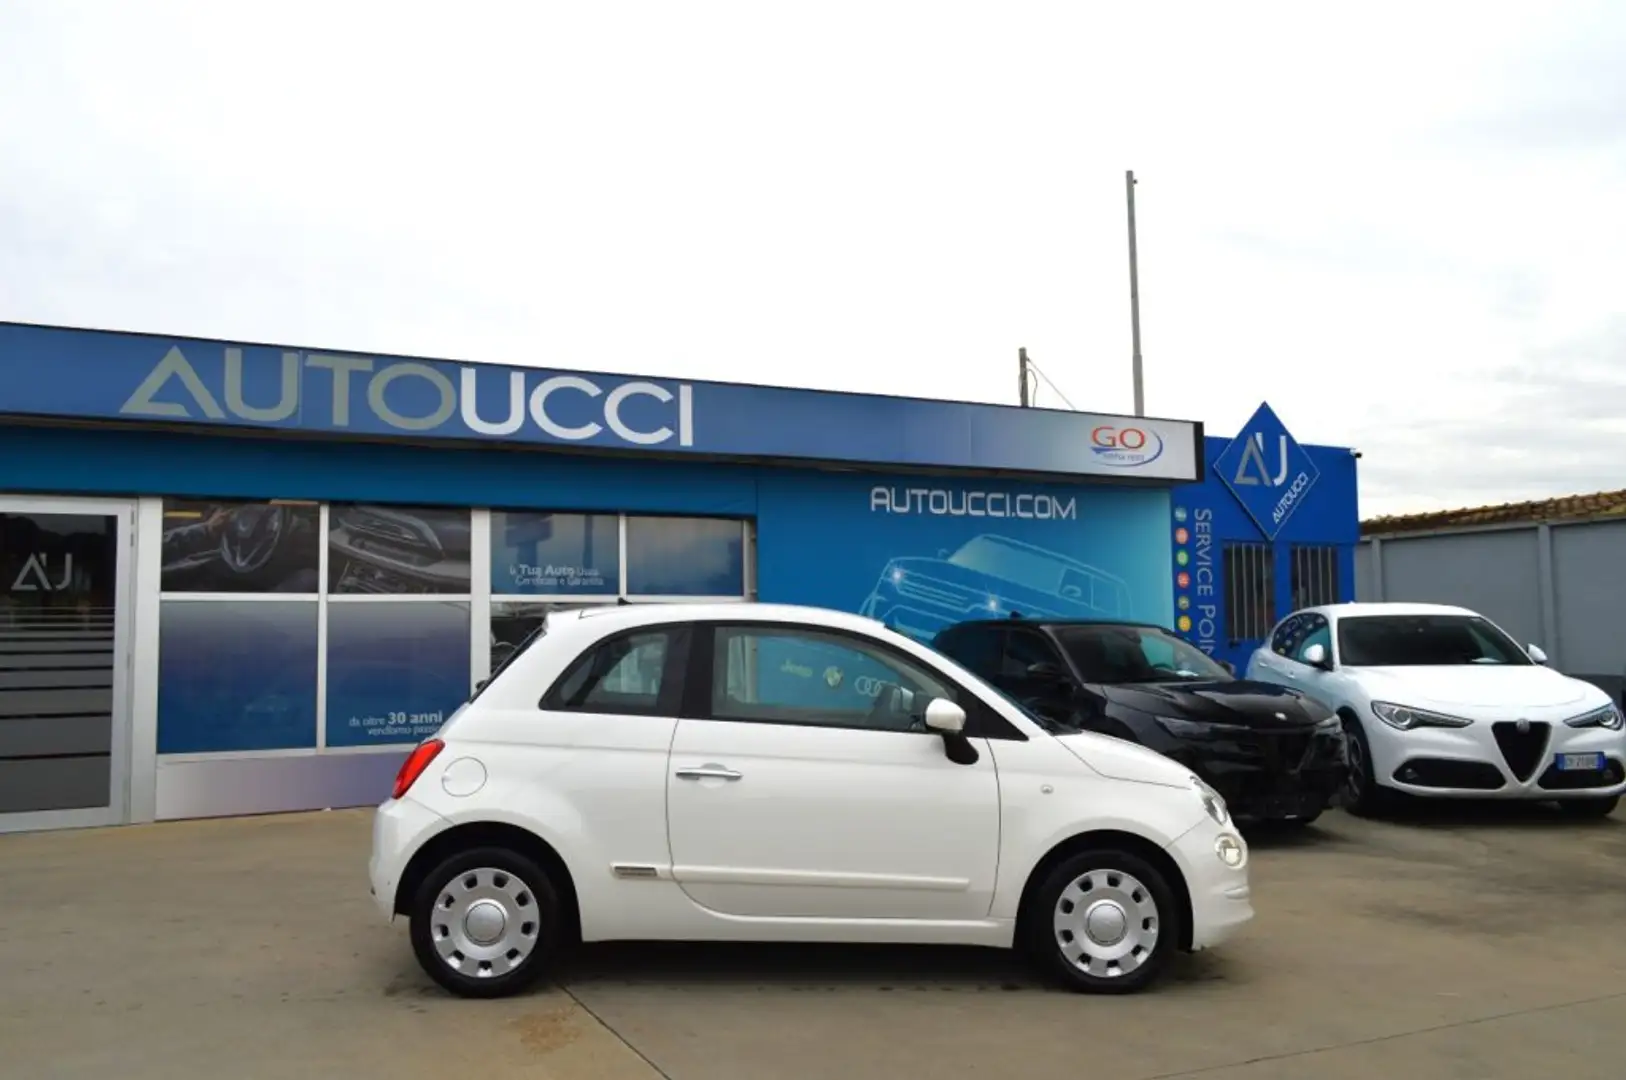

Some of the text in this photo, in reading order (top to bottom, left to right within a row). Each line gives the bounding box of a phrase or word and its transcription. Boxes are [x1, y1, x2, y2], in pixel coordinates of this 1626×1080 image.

[118, 345, 693, 448] AUTOUCCI
[1091, 425, 1146, 449] GO
[870, 486, 1077, 520] AUTOUCCI.COM
[1272, 471, 1309, 525] AUTOUCCI
[1194, 508, 1213, 596] SERVICE
[544, 564, 575, 576] Auto
[387, 711, 407, 725] 30
[409, 709, 444, 724] anni
